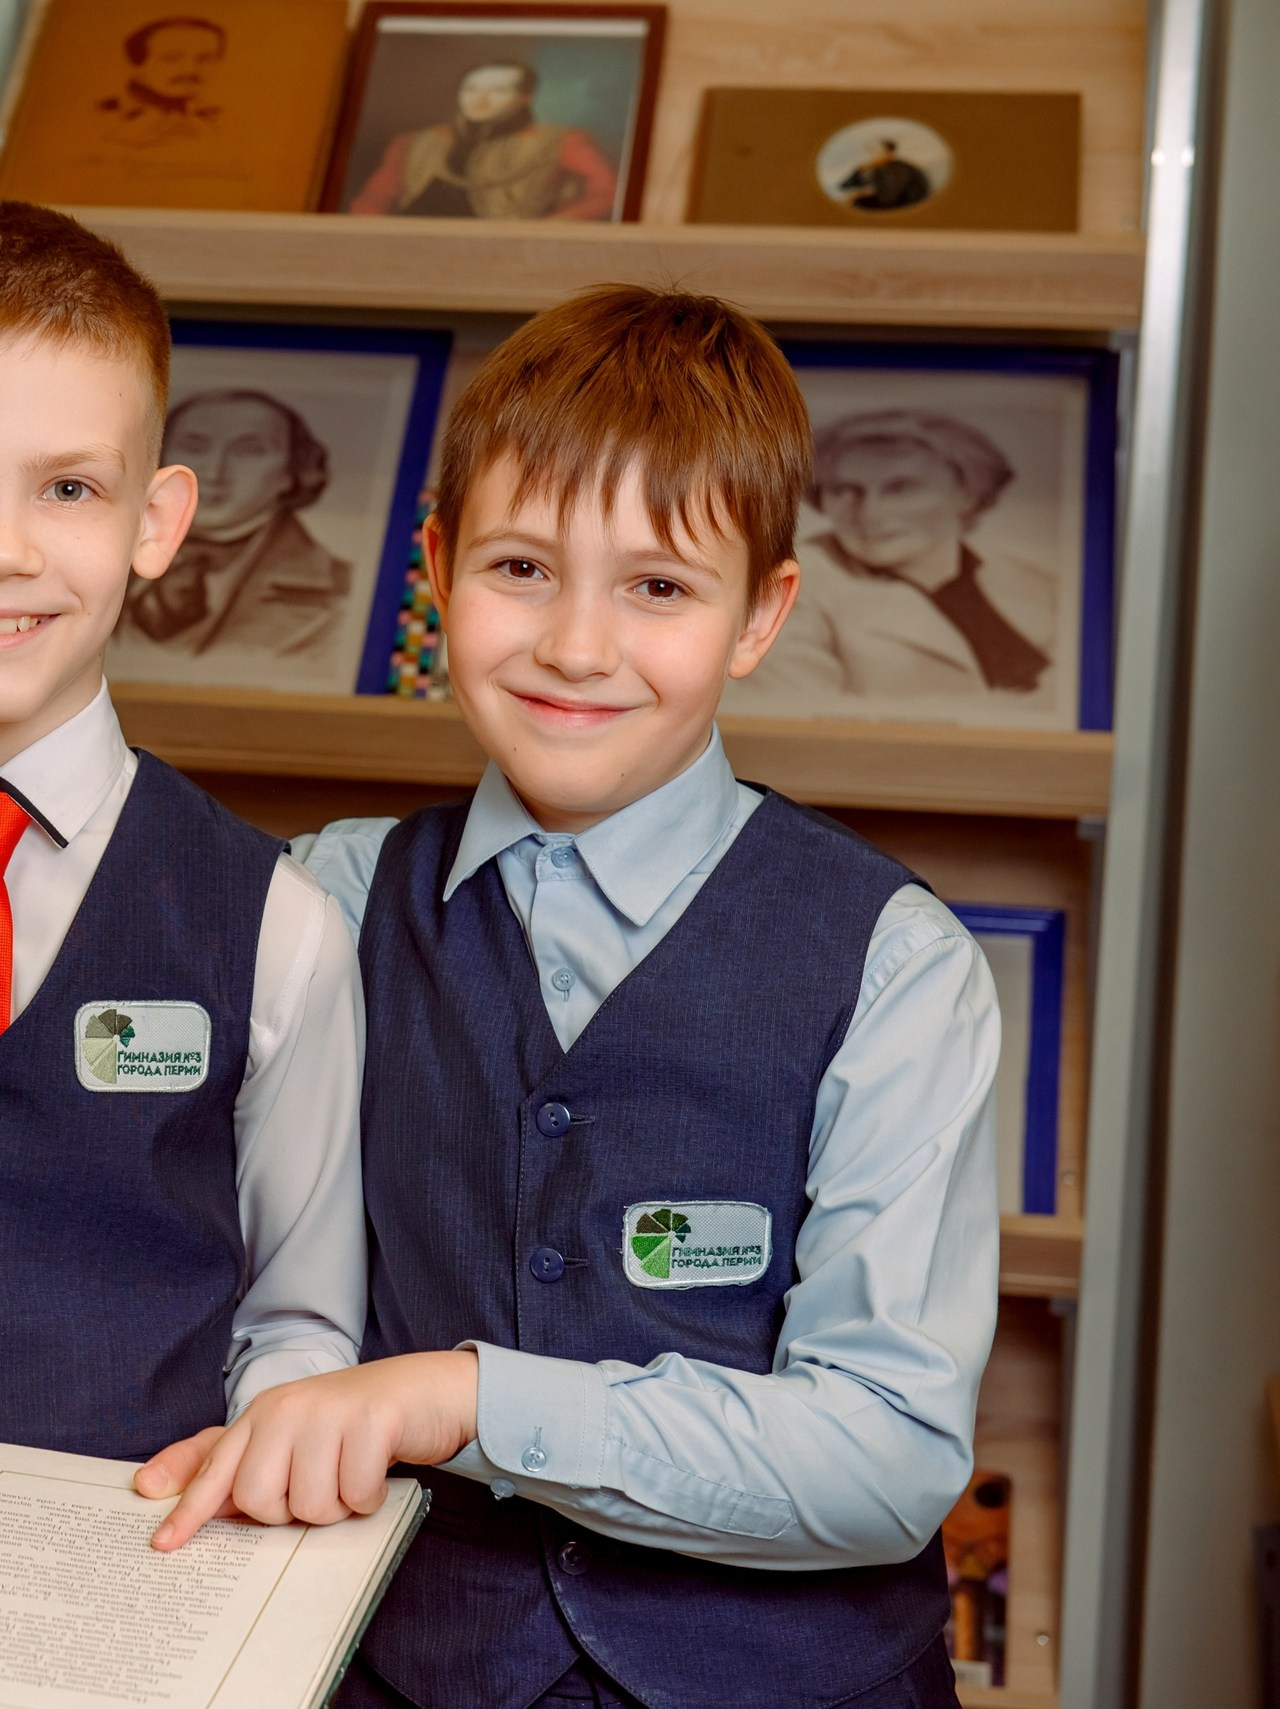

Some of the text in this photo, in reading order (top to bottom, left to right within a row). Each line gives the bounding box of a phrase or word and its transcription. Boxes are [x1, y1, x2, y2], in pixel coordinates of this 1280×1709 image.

[118, 1051, 181, 1063] ГИМНАЗИЯ
[118, 1064, 201, 1076] ГОРОДА ПЕРМИ
[672, 1246, 740, 1257] ГИМНАЗИЯ
[672, 1256, 762, 1269] ГОРОДА ПЕРМИ
